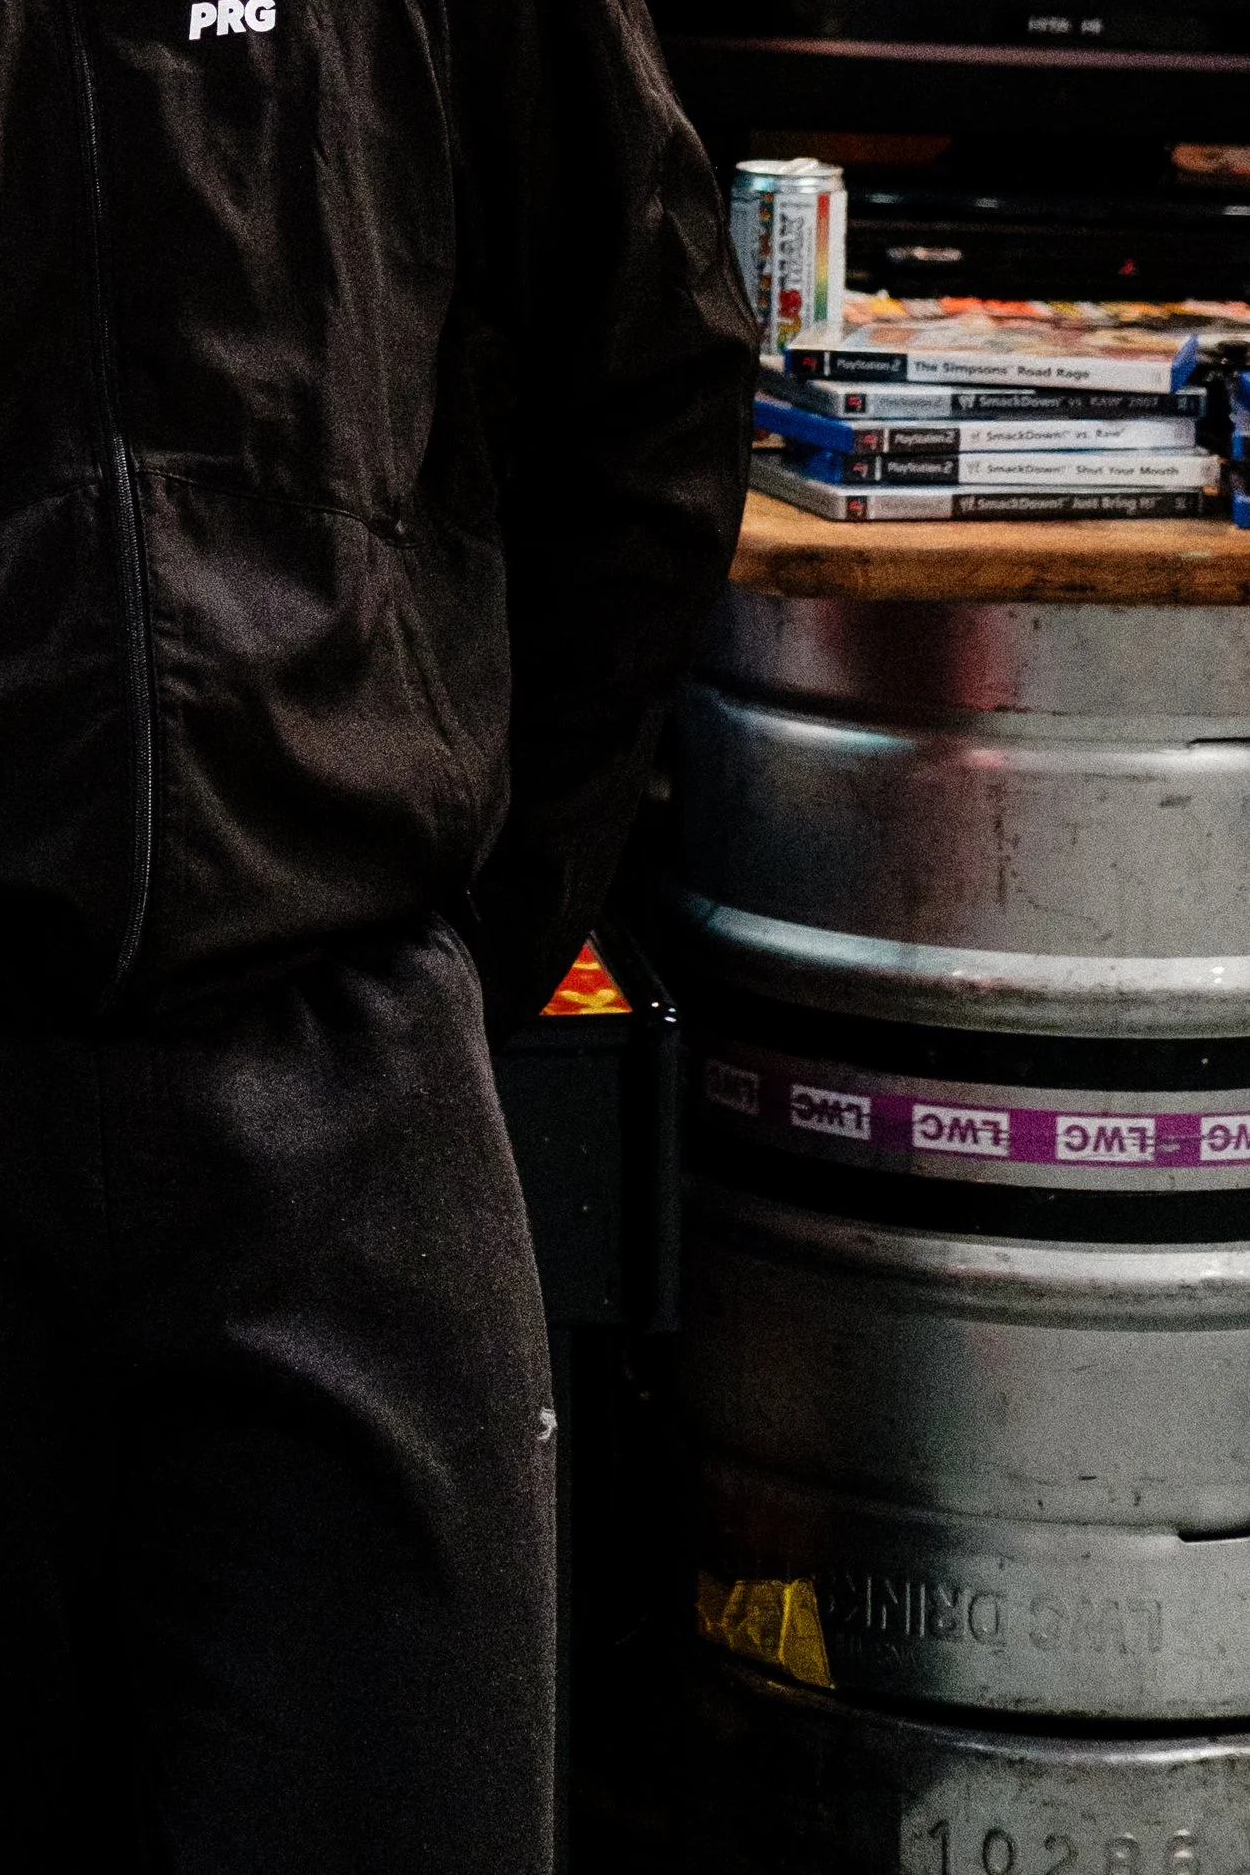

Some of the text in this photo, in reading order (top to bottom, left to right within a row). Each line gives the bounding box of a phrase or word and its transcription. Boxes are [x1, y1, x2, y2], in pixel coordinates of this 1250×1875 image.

[915, 361, 937, 372] The
[943, 363, 1007, 376] Simpsons
[1018, 366, 1051, 377] Road
[1057, 368, 1090, 380] Rage
[1076, 464, 1103, 475] Shut
[1108, 465, 1134, 476] Your
[1140, 466, 1179, 476] Mouth
[1073, 497, 1099, 509] Just
[1102, 497, 1137, 515] Bring
[793, 1092, 863, 1133] LWC
[920, 1113, 1002, 1150] LWC
[1064, 1124, 1149, 1152] LWC
[1029, 1597, 1163, 1654] LWC
